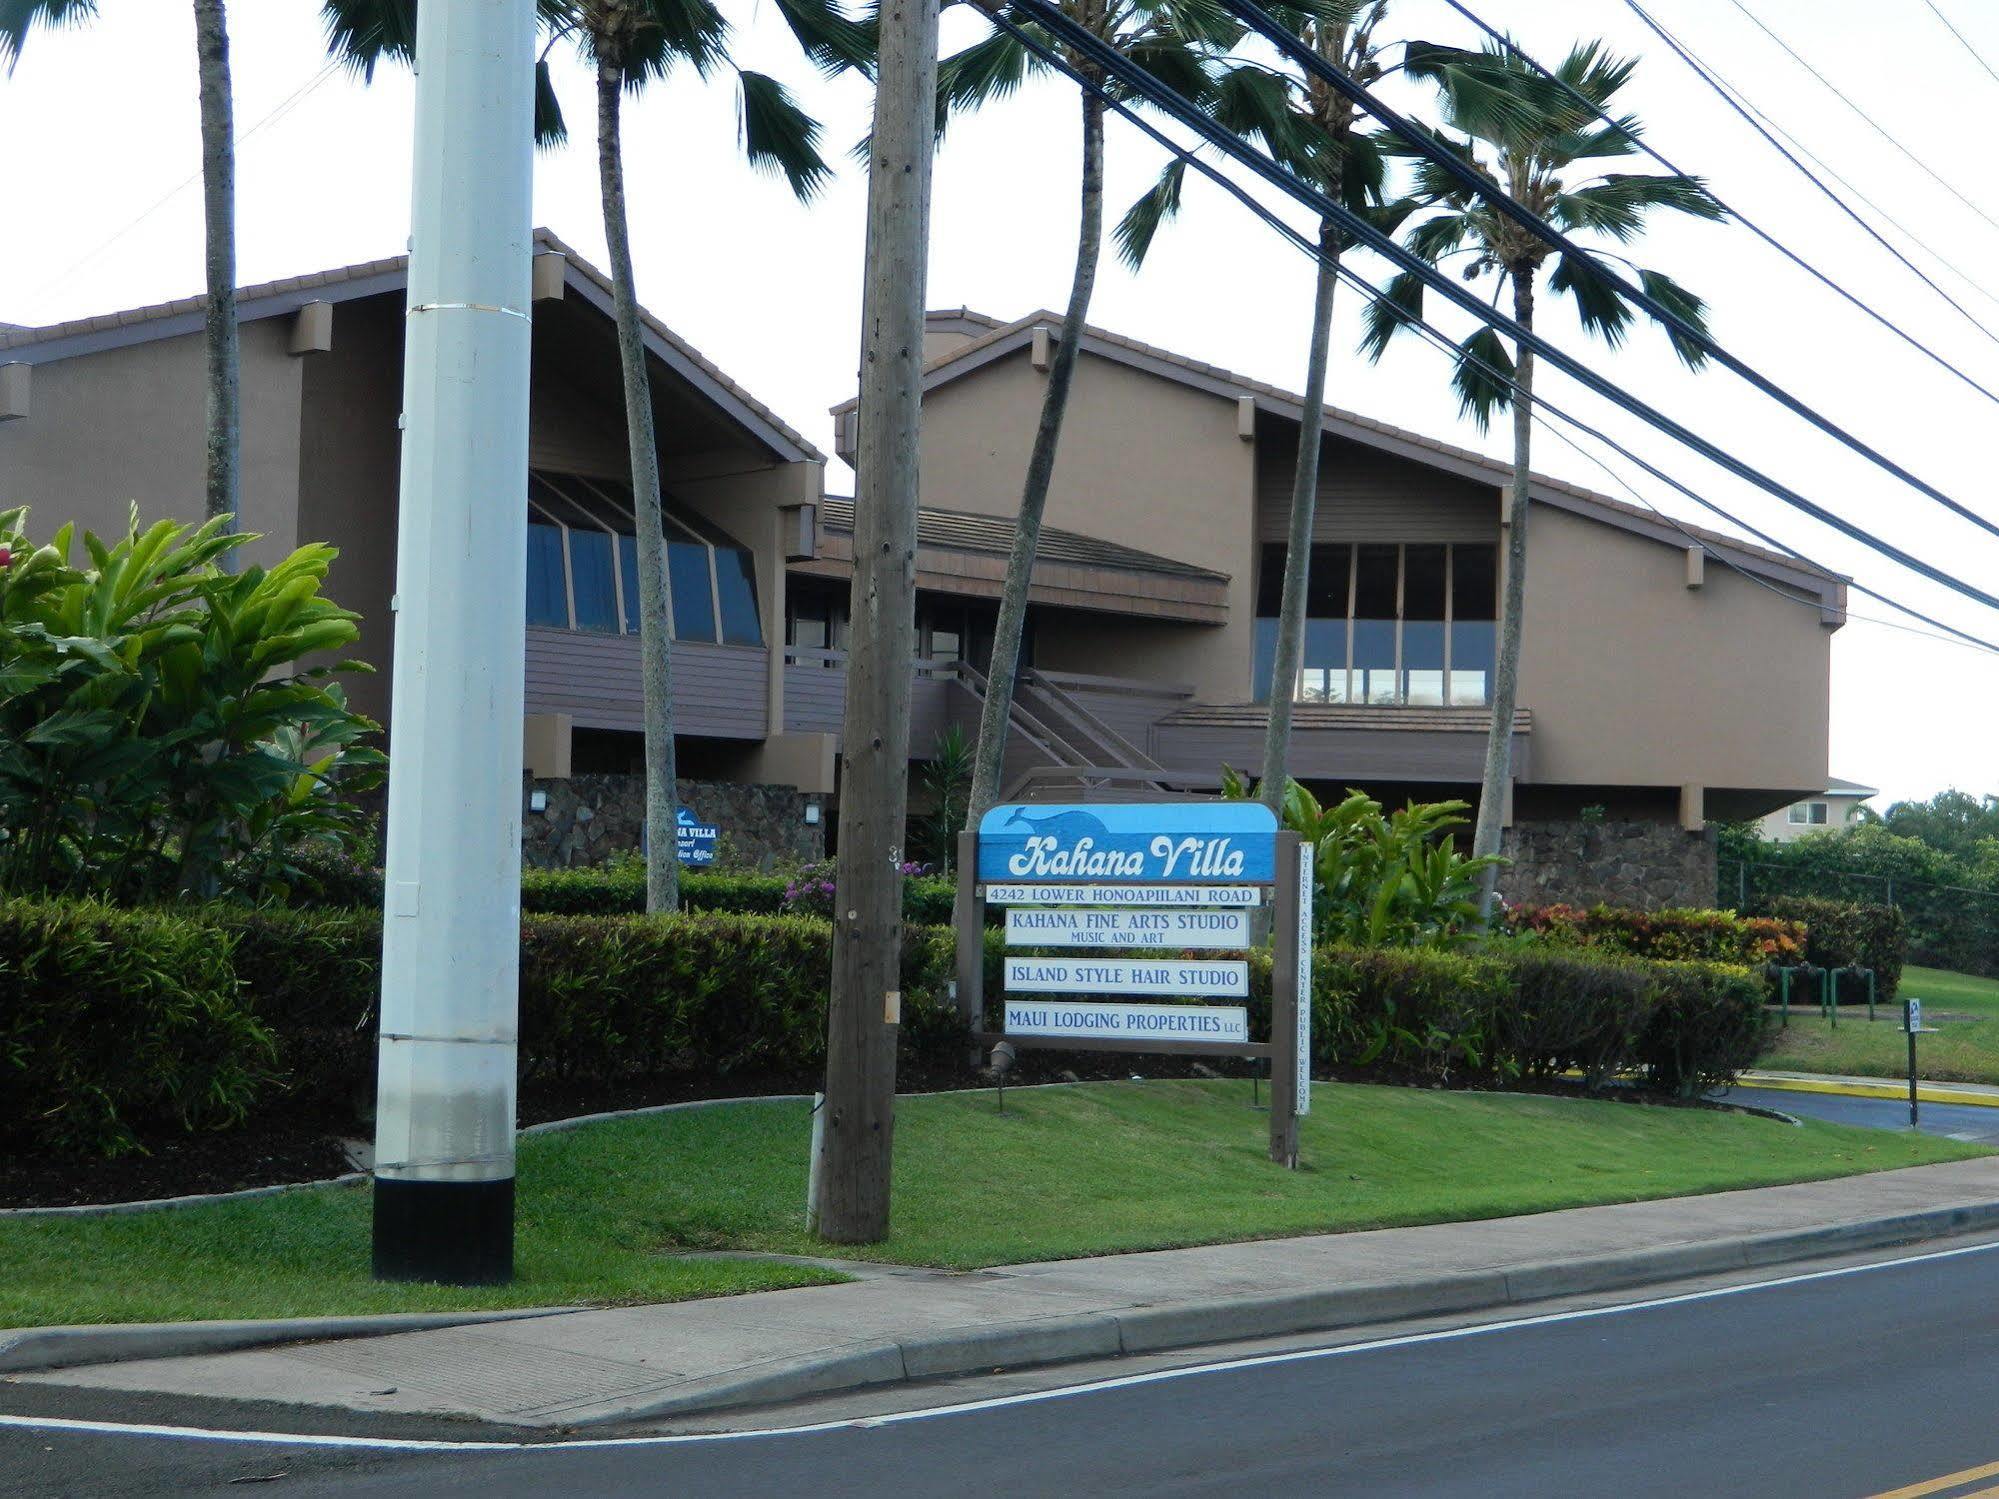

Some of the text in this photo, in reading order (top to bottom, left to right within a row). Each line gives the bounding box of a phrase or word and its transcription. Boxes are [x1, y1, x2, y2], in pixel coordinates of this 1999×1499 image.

[689, 827, 716, 838] VILLA
[1008, 835, 1244, 877] Kahana Villa
[990, 889, 1253, 902] 4242 LOWER HONOAPIILANI ROAD
[1012, 914, 1239, 930] KAHANA FINE ARTS STUDIO
[1071, 932, 1165, 943] MUSIC AND ART
[1012, 966, 1239, 986] ISLAND STYLE HAIR STUDIO
[1009, 1010, 1240, 1033] MAUI LODGING PROPERTIES LLC
